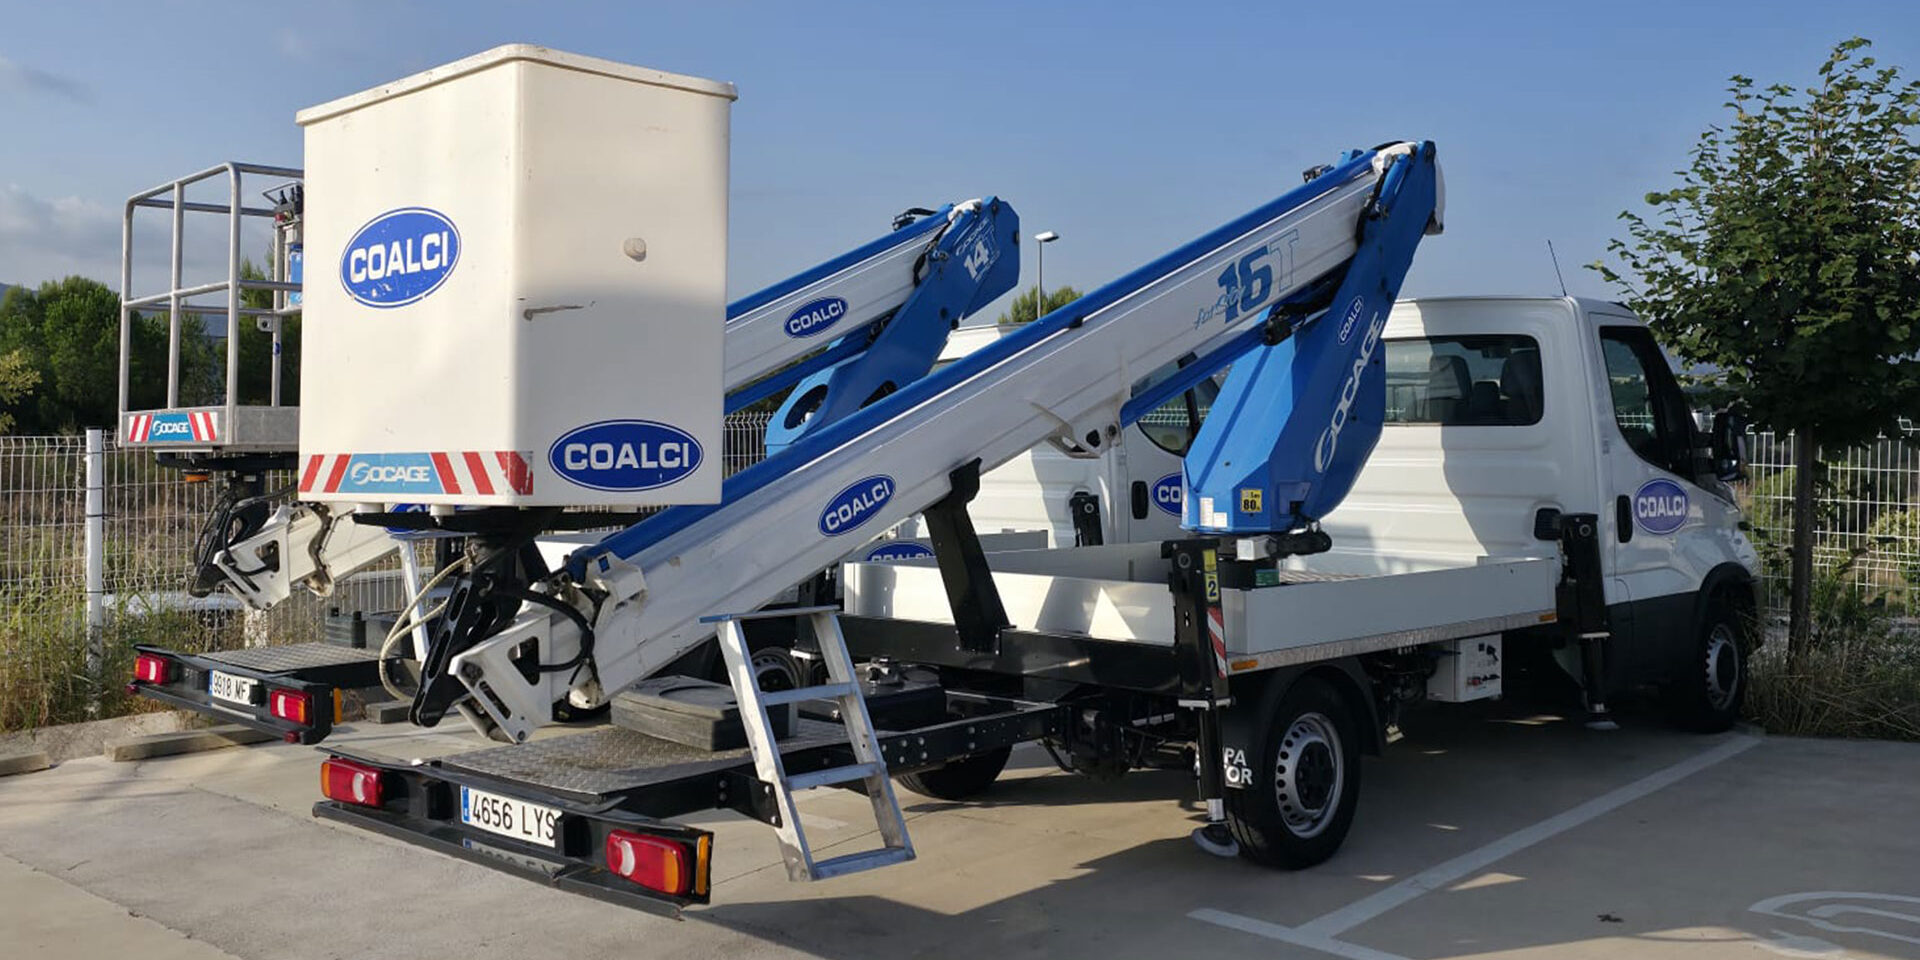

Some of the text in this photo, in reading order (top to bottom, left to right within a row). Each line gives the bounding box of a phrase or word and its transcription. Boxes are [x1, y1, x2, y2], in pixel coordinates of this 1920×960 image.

[350, 231, 449, 284] COALCI
[789, 300, 844, 334] COALCI
[1339, 299, 1363, 342] COALCI
[152, 420, 189, 436] SOCAGE
[564, 442, 690, 471] COALCI
[351, 462, 431, 486] SOCAGE
[825, 480, 891, 531] COALCI
[1157, 485, 1182, 503] CO
[1243, 499, 1257, 510] 80
[1637, 495, 1686, 518] COALCI
[1208, 580, 1216, 597] 2
[235, 679, 250, 700] MF
[1223, 746, 1247, 767] PA
[1224, 764, 1252, 785] OR
[472, 794, 556, 841] 4656 LYS
